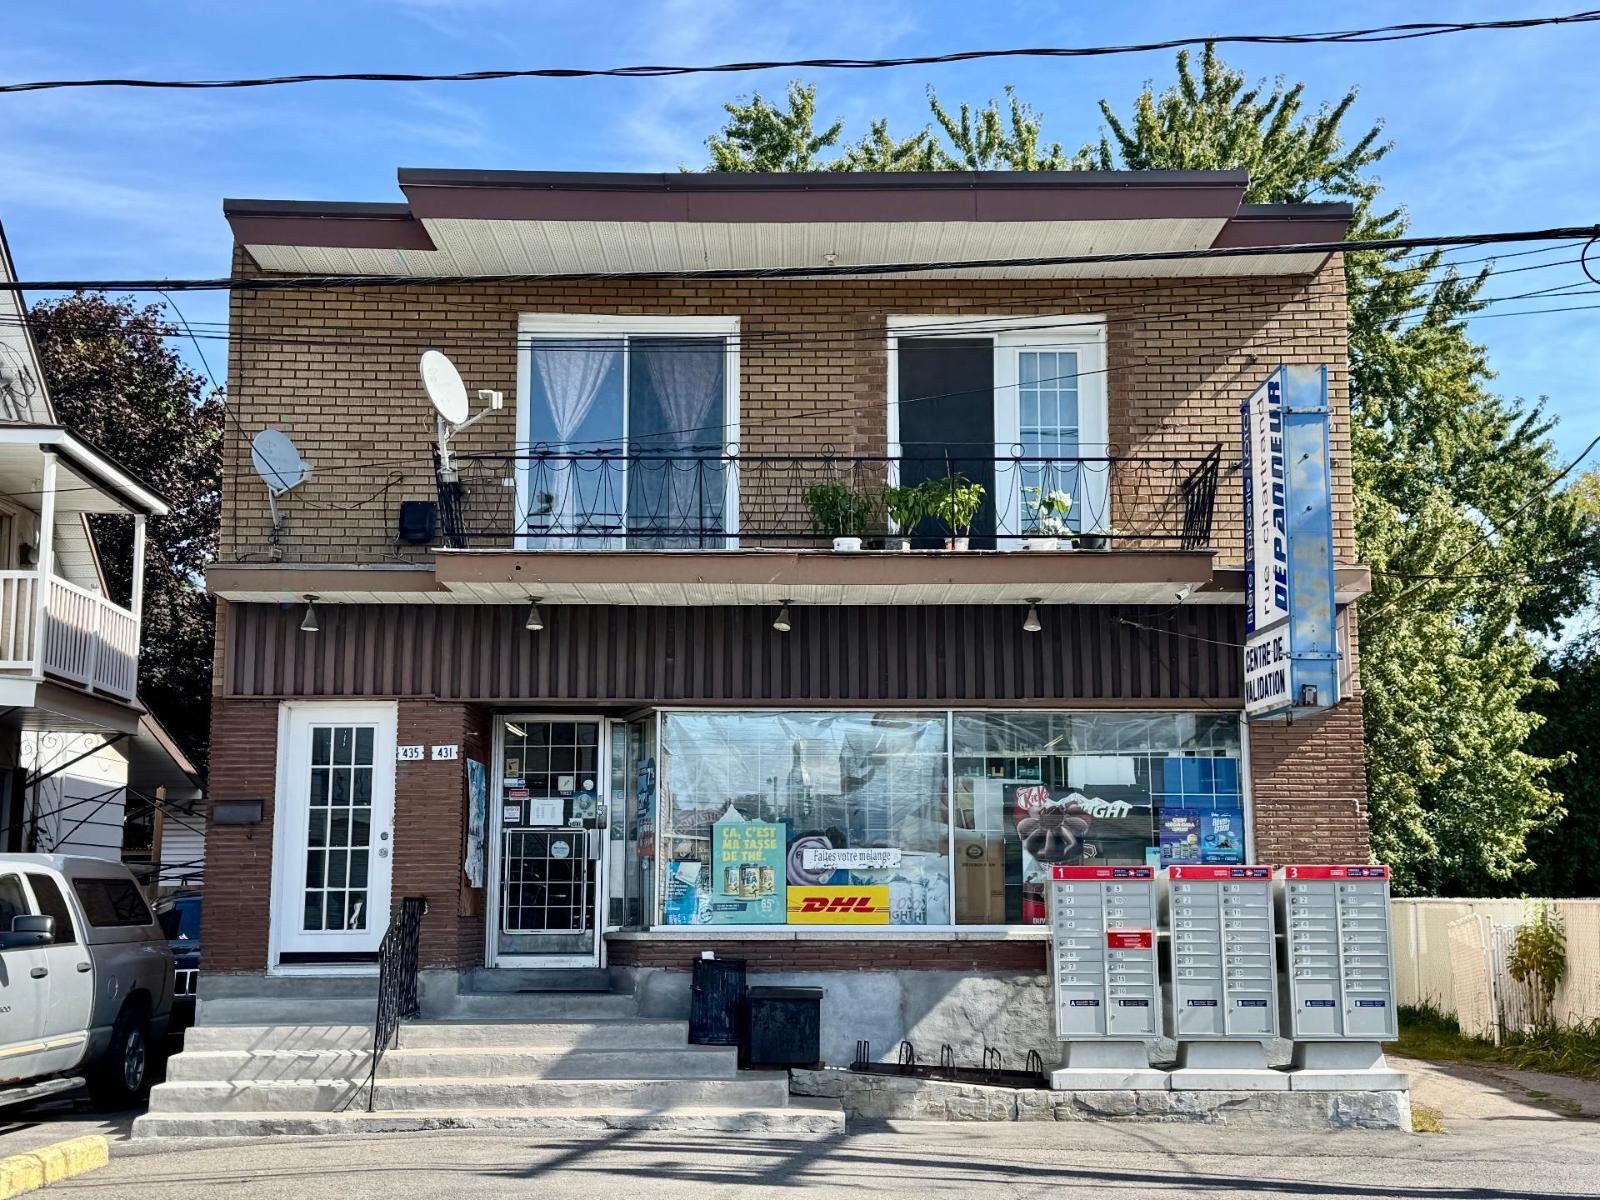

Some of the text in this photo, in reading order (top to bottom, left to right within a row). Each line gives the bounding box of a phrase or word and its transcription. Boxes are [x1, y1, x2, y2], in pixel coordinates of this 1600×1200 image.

[1246, 636, 1283, 674] CENTRE DE
[1246, 668, 1286, 704] VALIDATION
[402, 747, 419, 759] 435
[437, 747, 452, 759] 431
[722, 839, 777, 850] MA TASSE
[722, 850, 737, 862] DE
[814, 849, 891, 864] Faites votre mélange
[1058, 867, 1064, 879] 1
[1175, 867, 1182, 879] 2
[1290, 867, 1298, 878] 3
[800, 897, 876, 913] DHL
